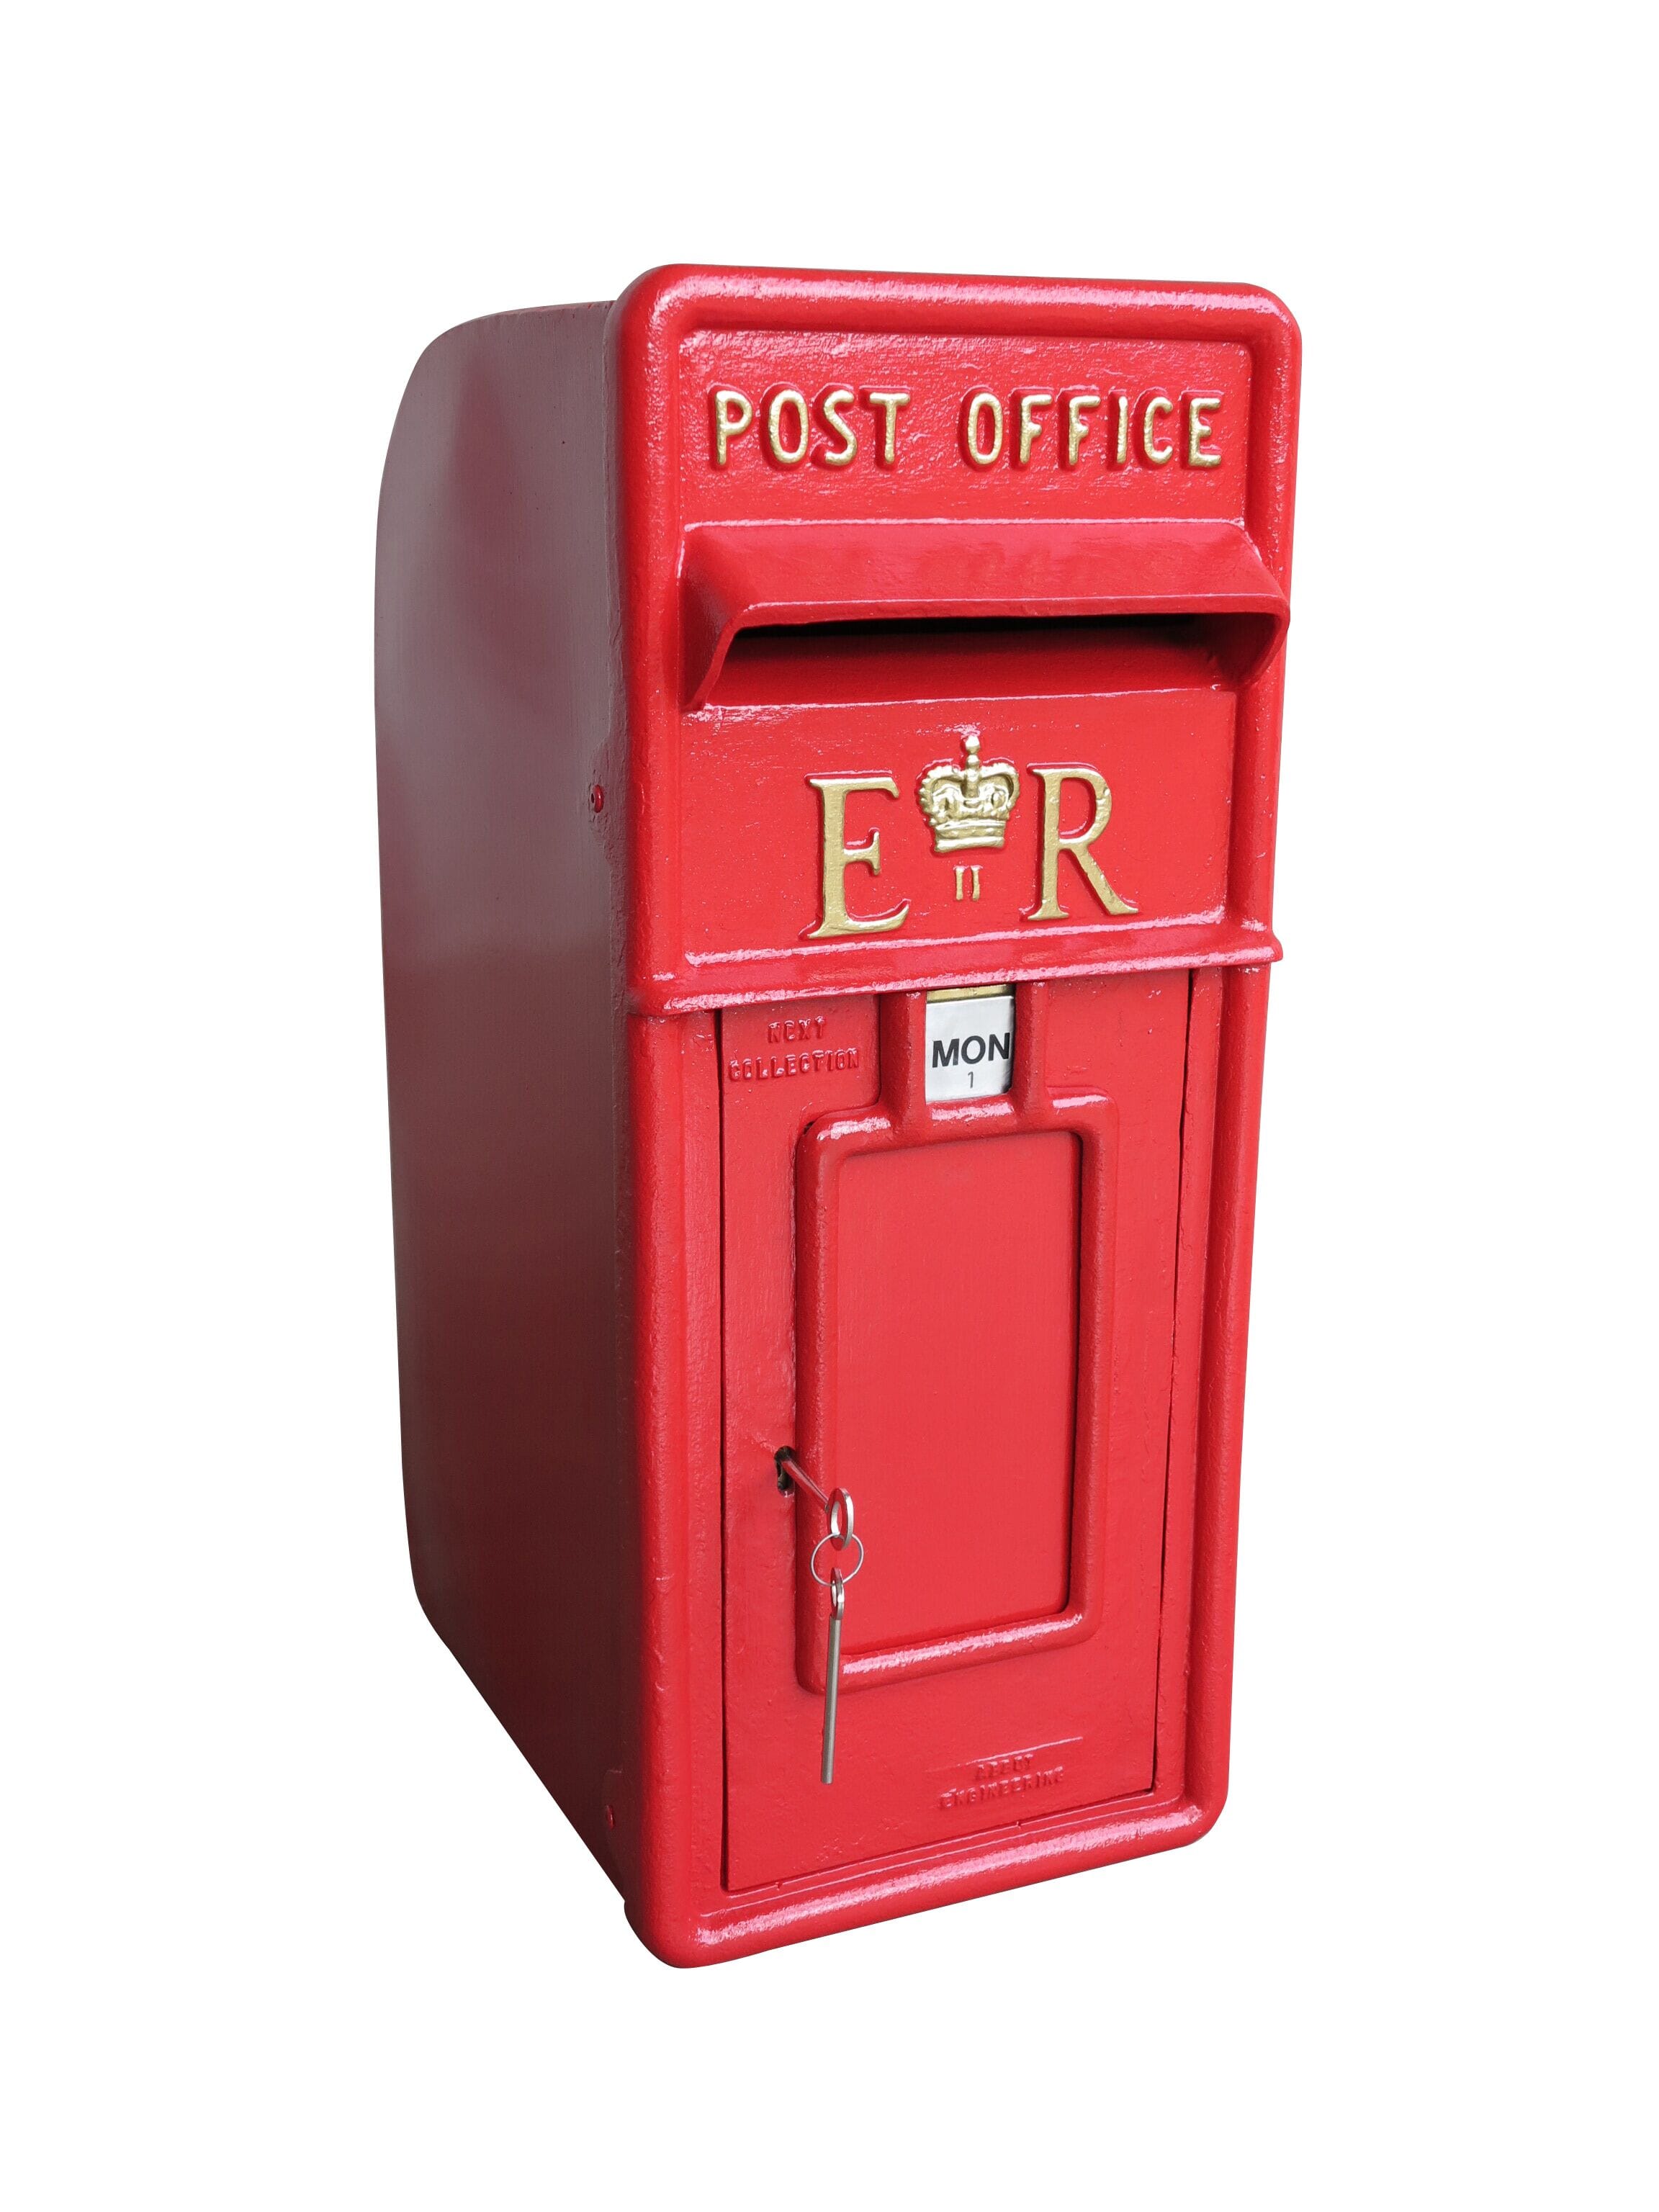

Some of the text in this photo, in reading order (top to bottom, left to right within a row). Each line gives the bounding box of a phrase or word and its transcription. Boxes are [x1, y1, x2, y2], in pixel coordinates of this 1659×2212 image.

[714, 388, 1223, 468] POST OFFICE
[808, 767, 1139, 940] E R
[953, 866, 981, 902] II
[768, 1015, 826, 1043] NEXT
[728, 1047, 859, 1083] COLLECTION
[932, 1032, 1011, 1069] MON
[967, 1071, 975, 1089] 1
[938, 1766, 1064, 1809] ENGINEERING
